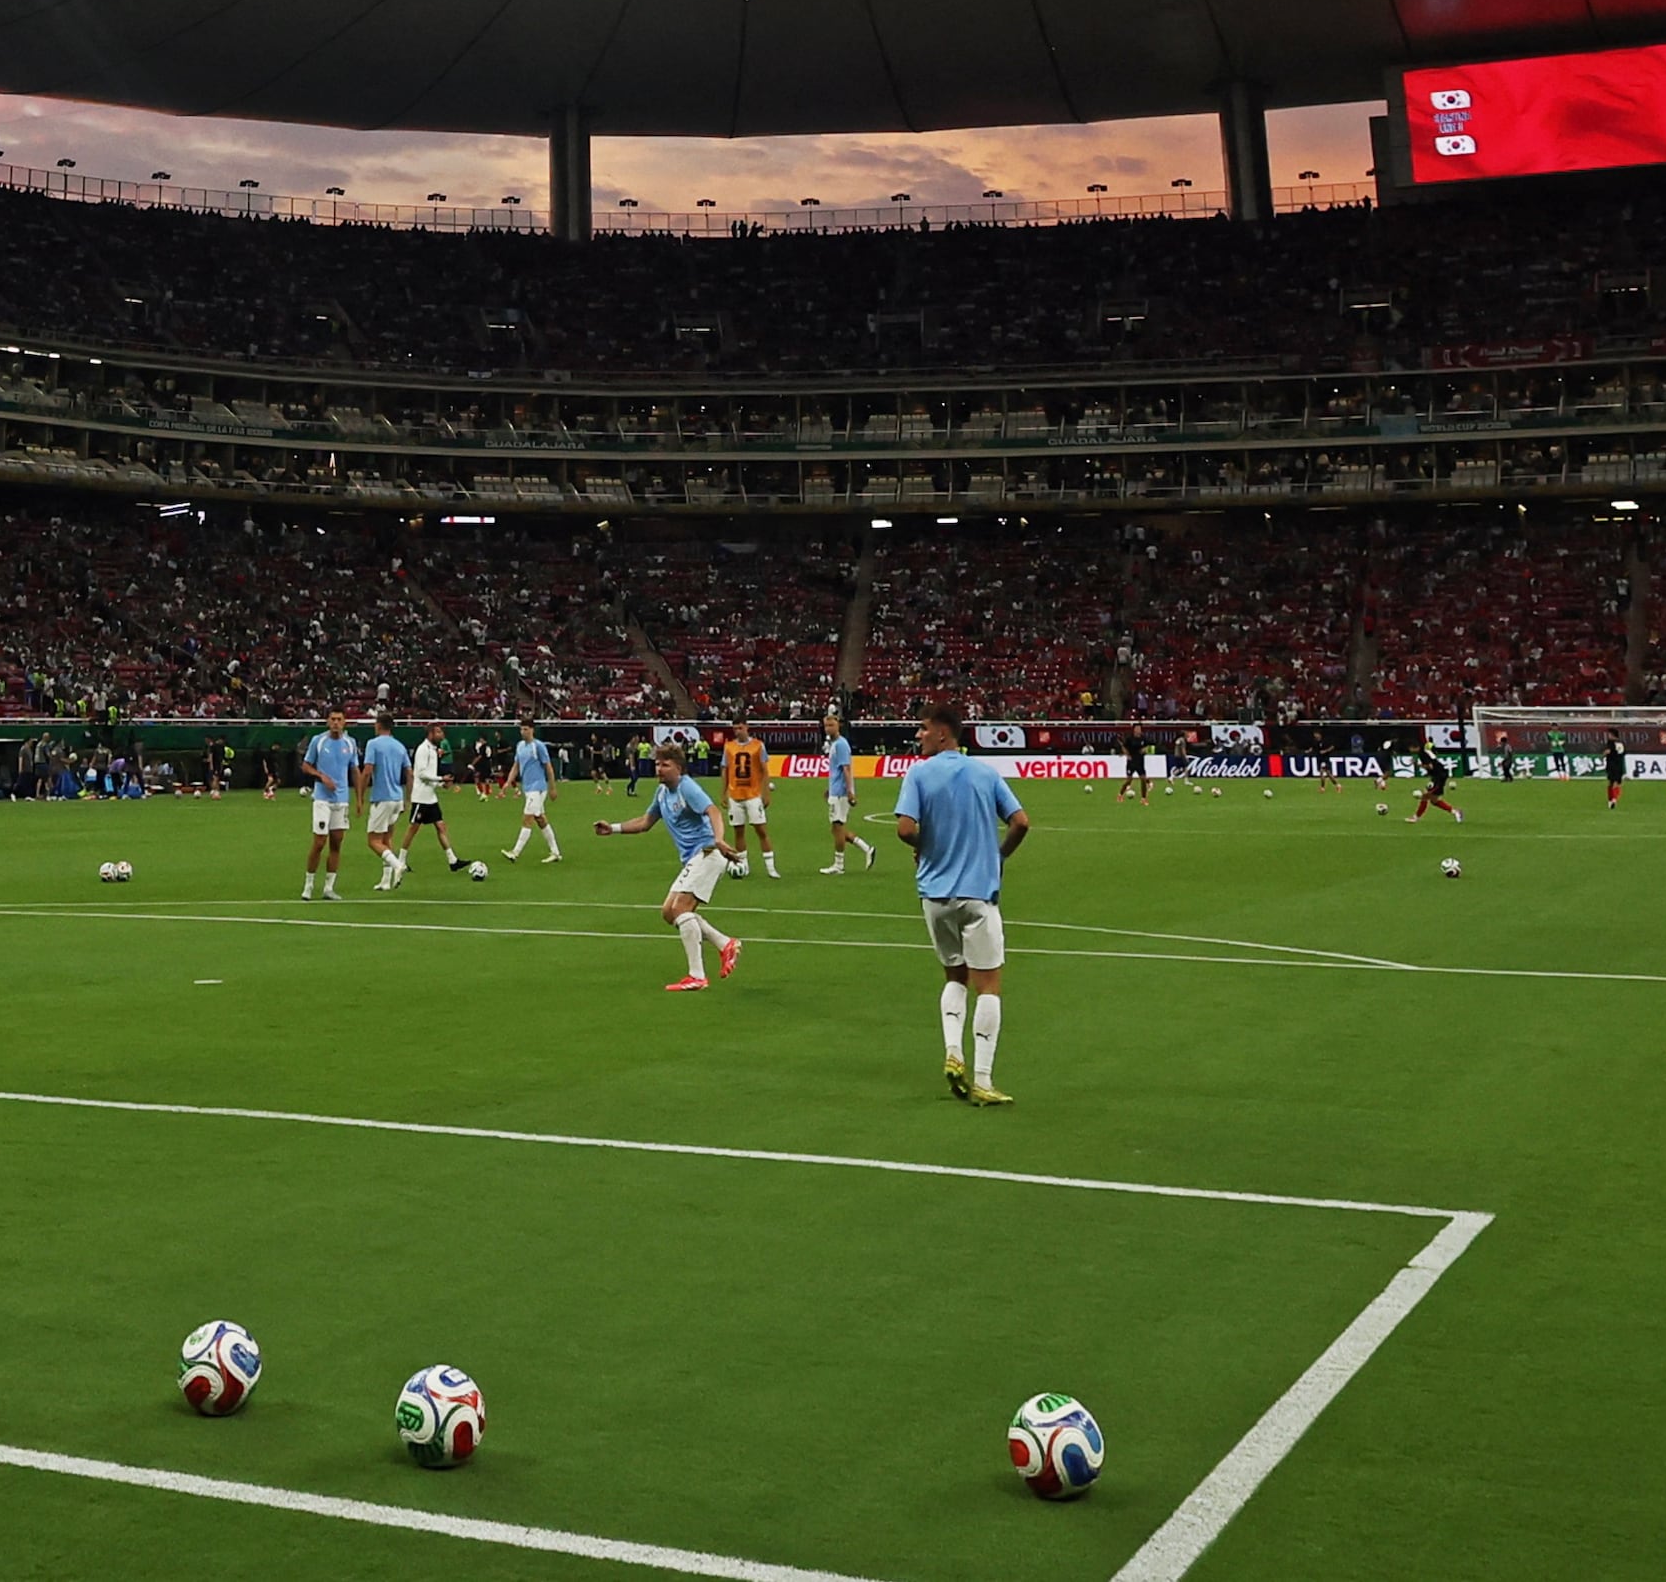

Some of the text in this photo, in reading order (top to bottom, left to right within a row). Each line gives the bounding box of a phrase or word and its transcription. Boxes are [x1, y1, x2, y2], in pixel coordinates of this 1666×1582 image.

[485, 440, 586, 450] GUADALAJARA
[1048, 436, 1157, 446] GUADALAJARA
[788, 754, 830, 778] Lay's
[1015, 756, 1108, 778] verizon
[1174, 755, 1262, 778] Michelob
[1289, 756, 1384, 777] ULTRA
